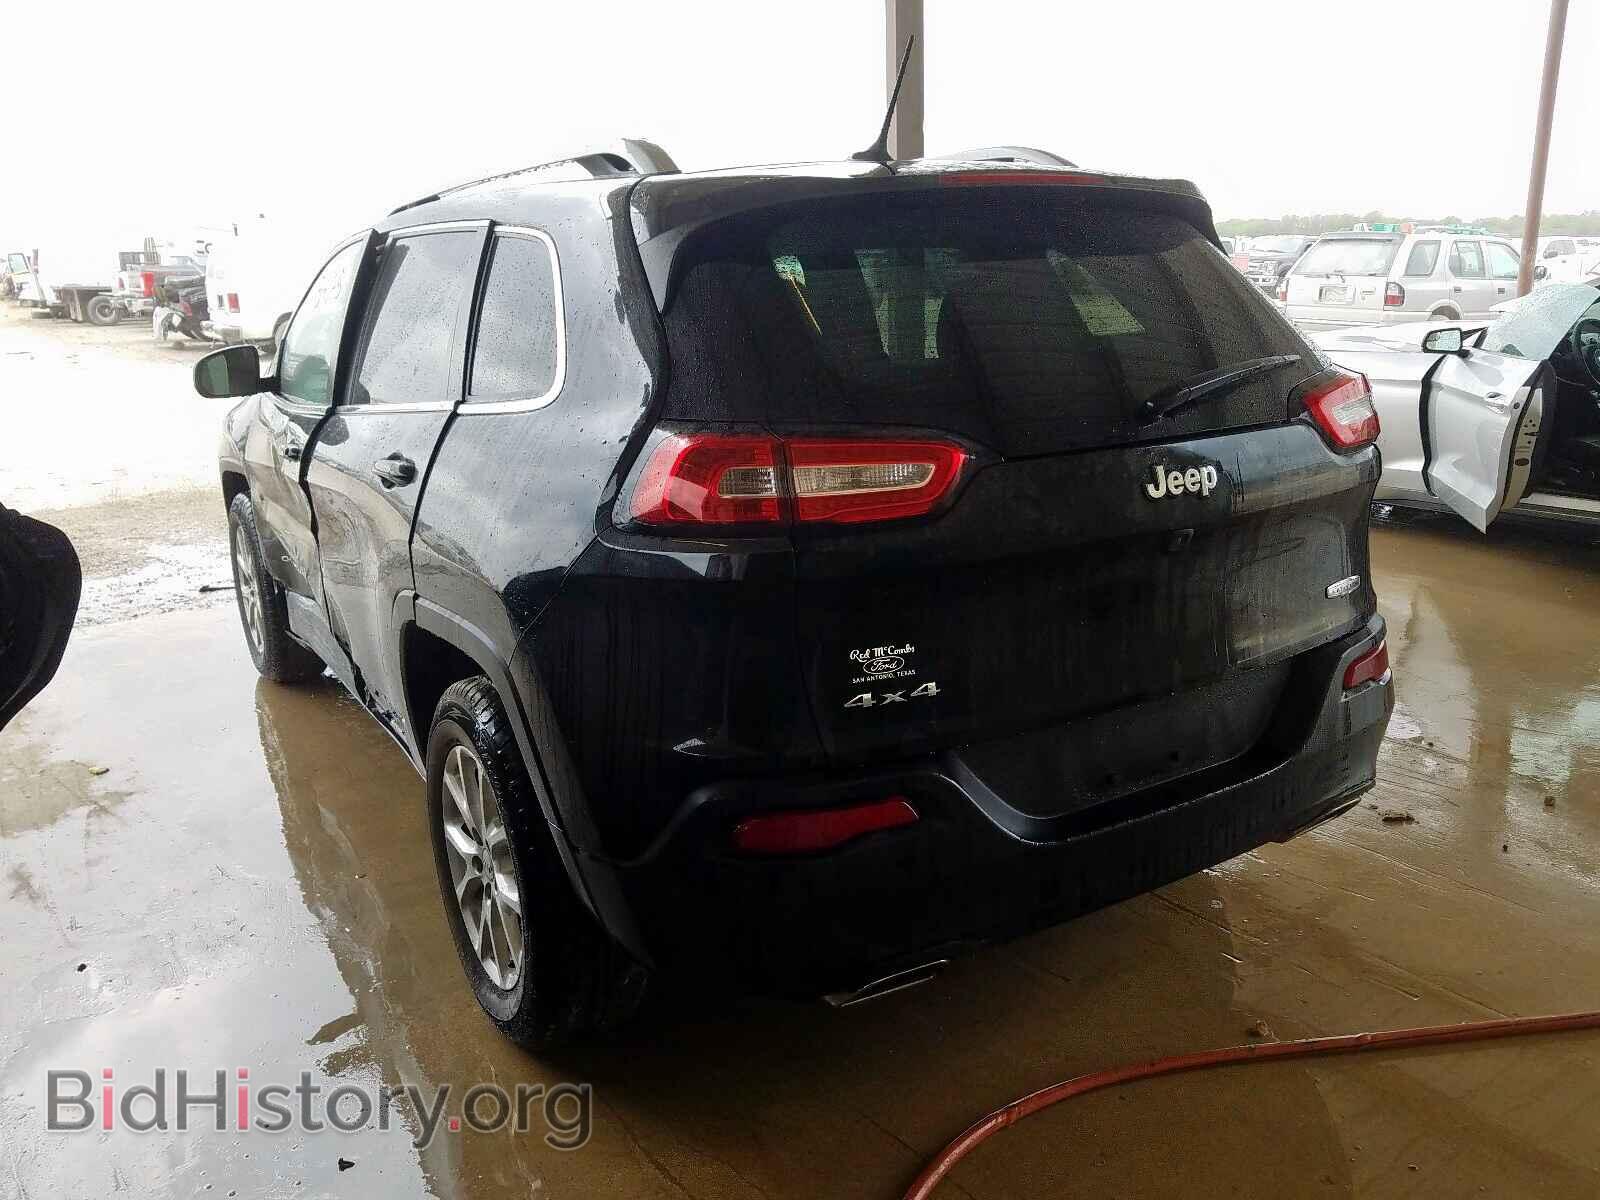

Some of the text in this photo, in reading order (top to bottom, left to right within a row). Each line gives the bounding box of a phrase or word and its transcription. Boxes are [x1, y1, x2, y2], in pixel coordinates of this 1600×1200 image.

[1146, 465, 1218, 498] Jeep
[850, 644, 915, 662] Red McCombs
[870, 659, 898, 671] Ford
[852, 676, 865, 684] SAN
[896, 669, 916, 677] TEXAS
